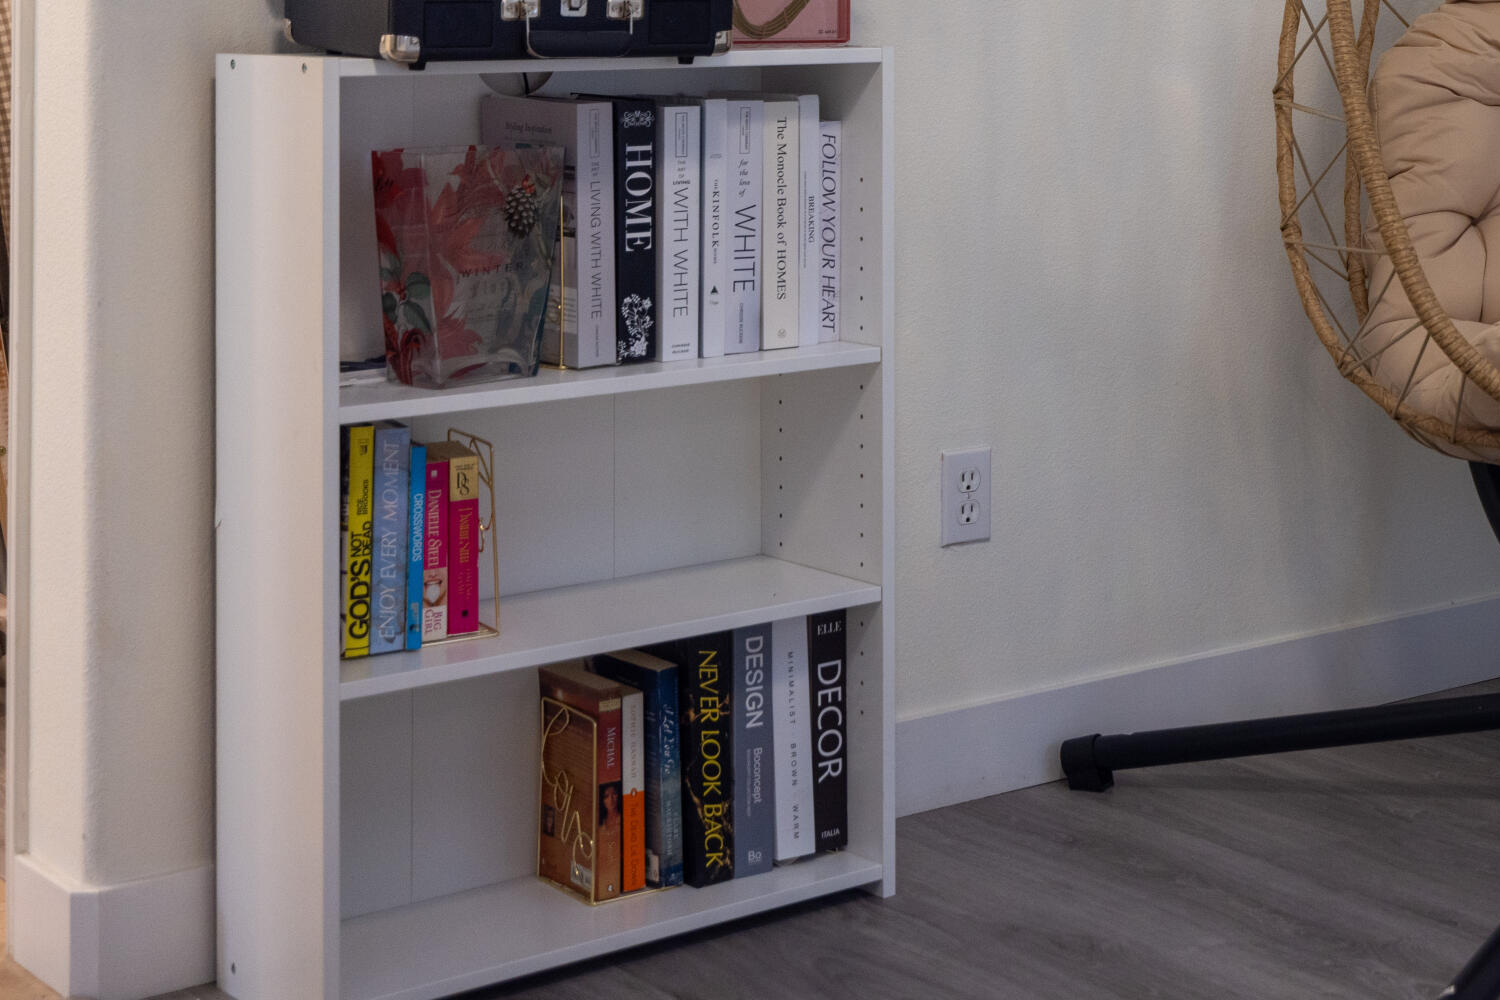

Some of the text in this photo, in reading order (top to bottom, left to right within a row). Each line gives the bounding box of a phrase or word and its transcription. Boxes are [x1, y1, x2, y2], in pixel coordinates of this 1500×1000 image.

[590, 181, 602, 228] LIVING
[625, 142, 653, 251] HOME
[712, 190, 720, 248] KINFOLK
[776, 116, 788, 300] The Monocle Book of HOMES
[590, 232, 602, 268] WITH
[673, 187, 689, 318] WITH WHITE
[733, 204, 757, 293] WHITE
[821, 134, 837, 333] FOLLOW YOUR HEART
[460, 262, 524, 278] WINTER
[590, 272, 602, 319] WHITE
[350, 531, 361, 558] NOT
[361, 520, 373, 557] DEAD
[379, 440, 400, 638] ENJOY EVERY MOMENT
[412, 493, 424, 562] CROSSWORDS
[427, 489, 443, 567] DANIELLE STEEL
[348, 559, 371, 640] GOD'S
[424, 609, 433, 634] GIRL
[432, 611, 443, 631] BIG
[817, 621, 842, 636] ELLE
[745, 635, 764, 729] DESIGN
[606, 727, 617, 768] MICHAL
[788, 651, 800, 840] MINIMALIST BROWN WARM
[817, 659, 843, 783] DECOR
[698, 650, 724, 868] NEVER LOOK BACK
[821, 827, 840, 839] ITALIA
